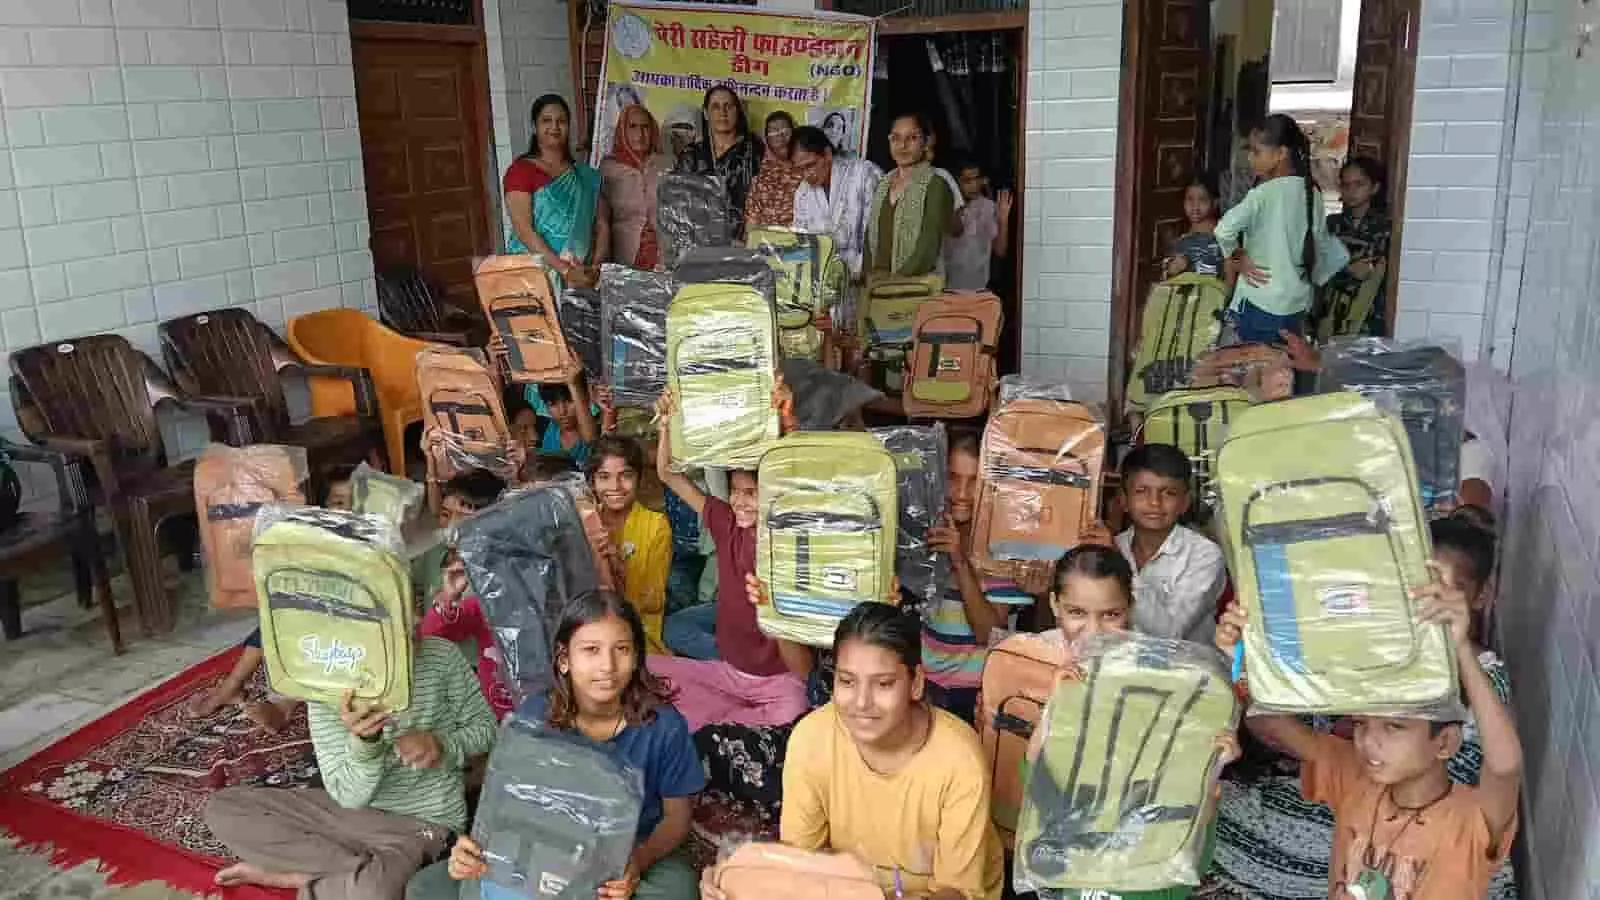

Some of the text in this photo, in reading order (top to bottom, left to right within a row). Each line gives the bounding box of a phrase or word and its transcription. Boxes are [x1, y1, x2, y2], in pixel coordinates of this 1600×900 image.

[689, 24, 745, 52] सहेली
[631, 70, 673, 86] आपका
[810, 63, 862, 78] (NGO)
